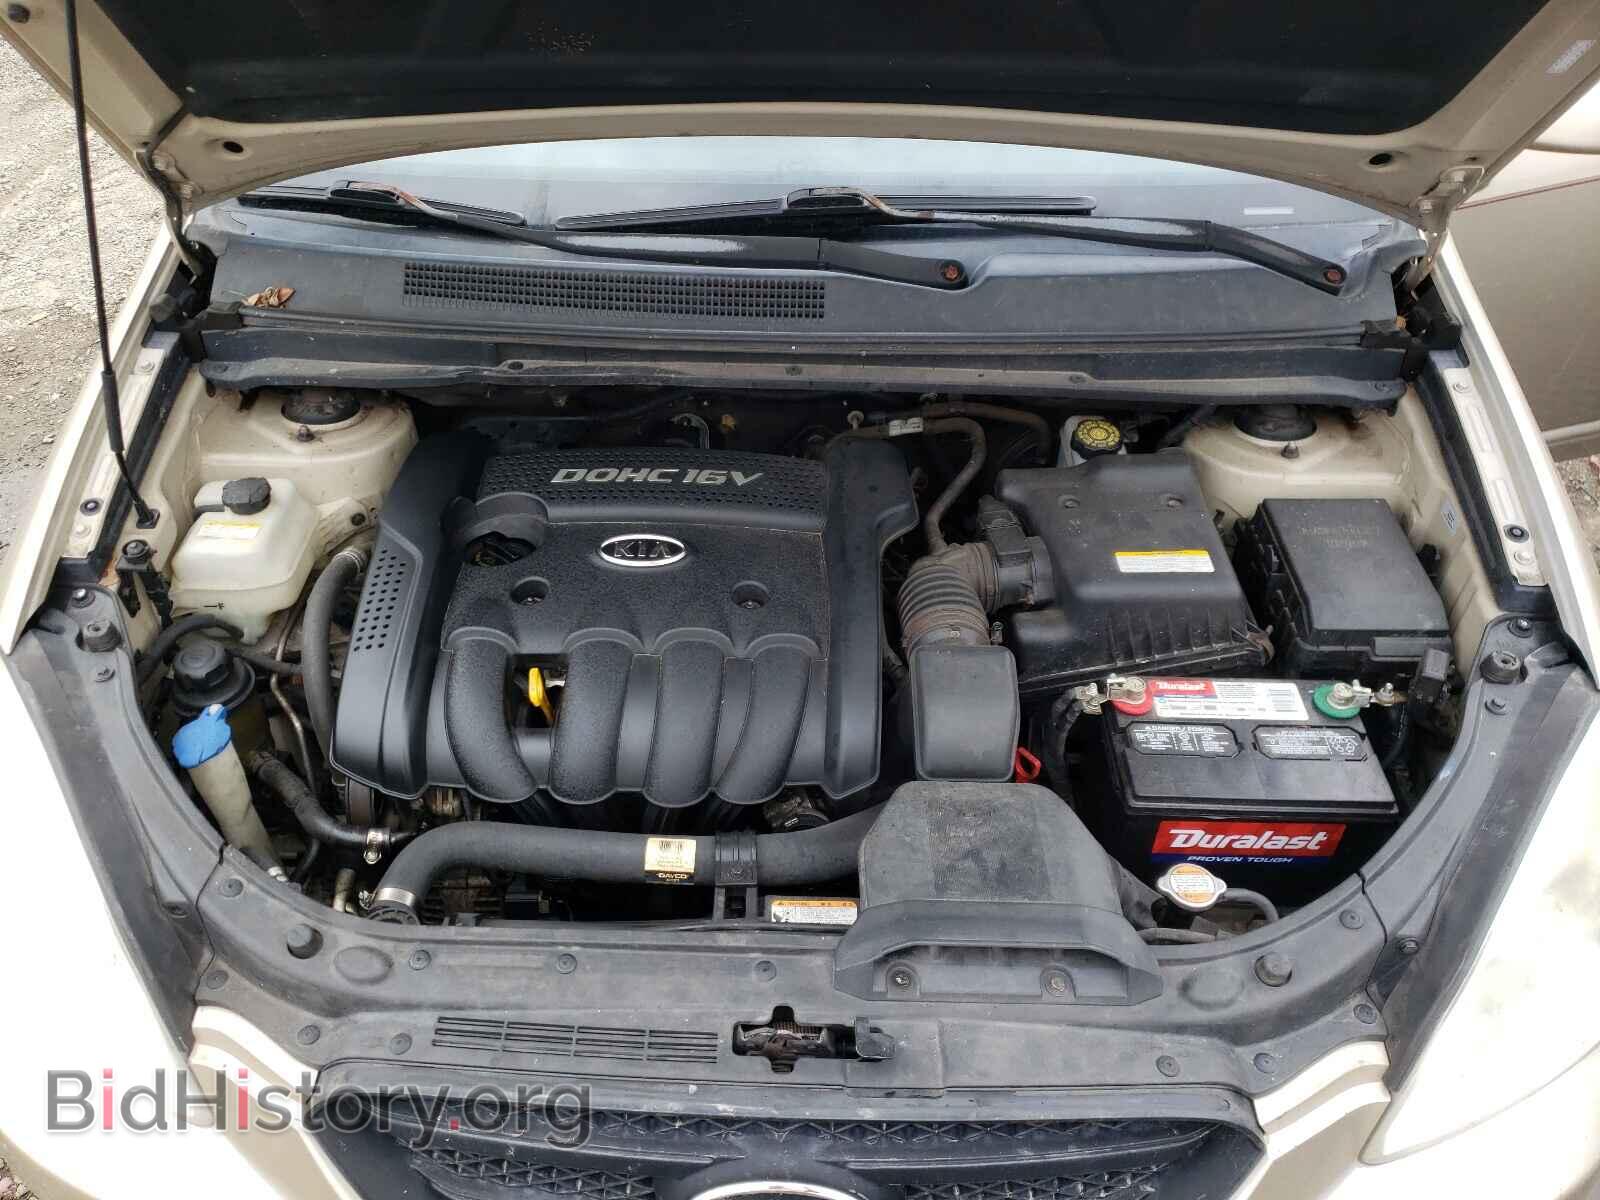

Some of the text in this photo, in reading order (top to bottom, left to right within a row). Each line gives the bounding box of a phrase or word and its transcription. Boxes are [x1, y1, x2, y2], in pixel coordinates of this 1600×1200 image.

[550, 468, 764, 486] DOHC 16V
[613, 541, 672, 558] KIA
[1156, 681, 1206, 691] Duralast
[1168, 829, 1328, 850] Duralast
